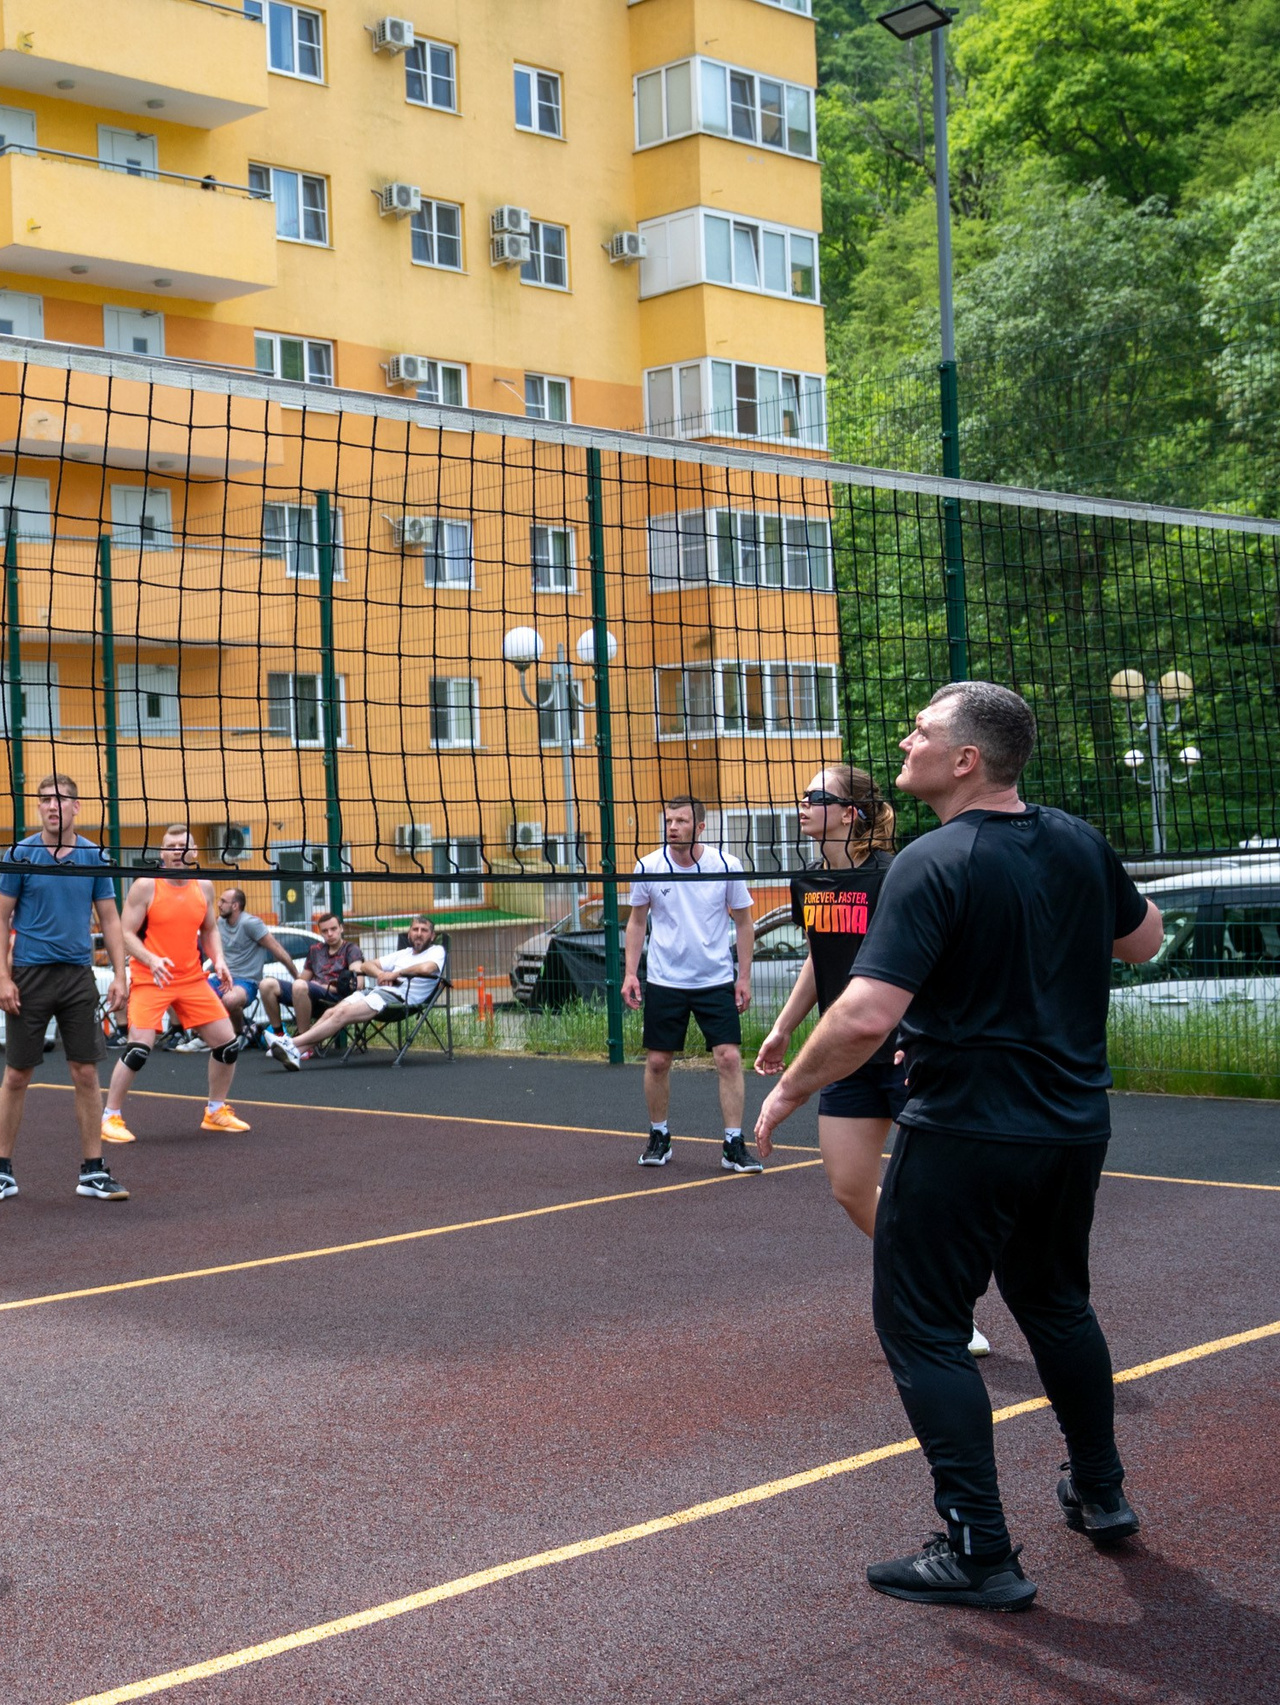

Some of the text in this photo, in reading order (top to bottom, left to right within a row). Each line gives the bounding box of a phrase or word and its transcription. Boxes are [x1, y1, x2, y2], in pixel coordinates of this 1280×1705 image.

[804, 891, 869, 905] FOREVER. FASTER.
[803, 904, 869, 935] PUMA
